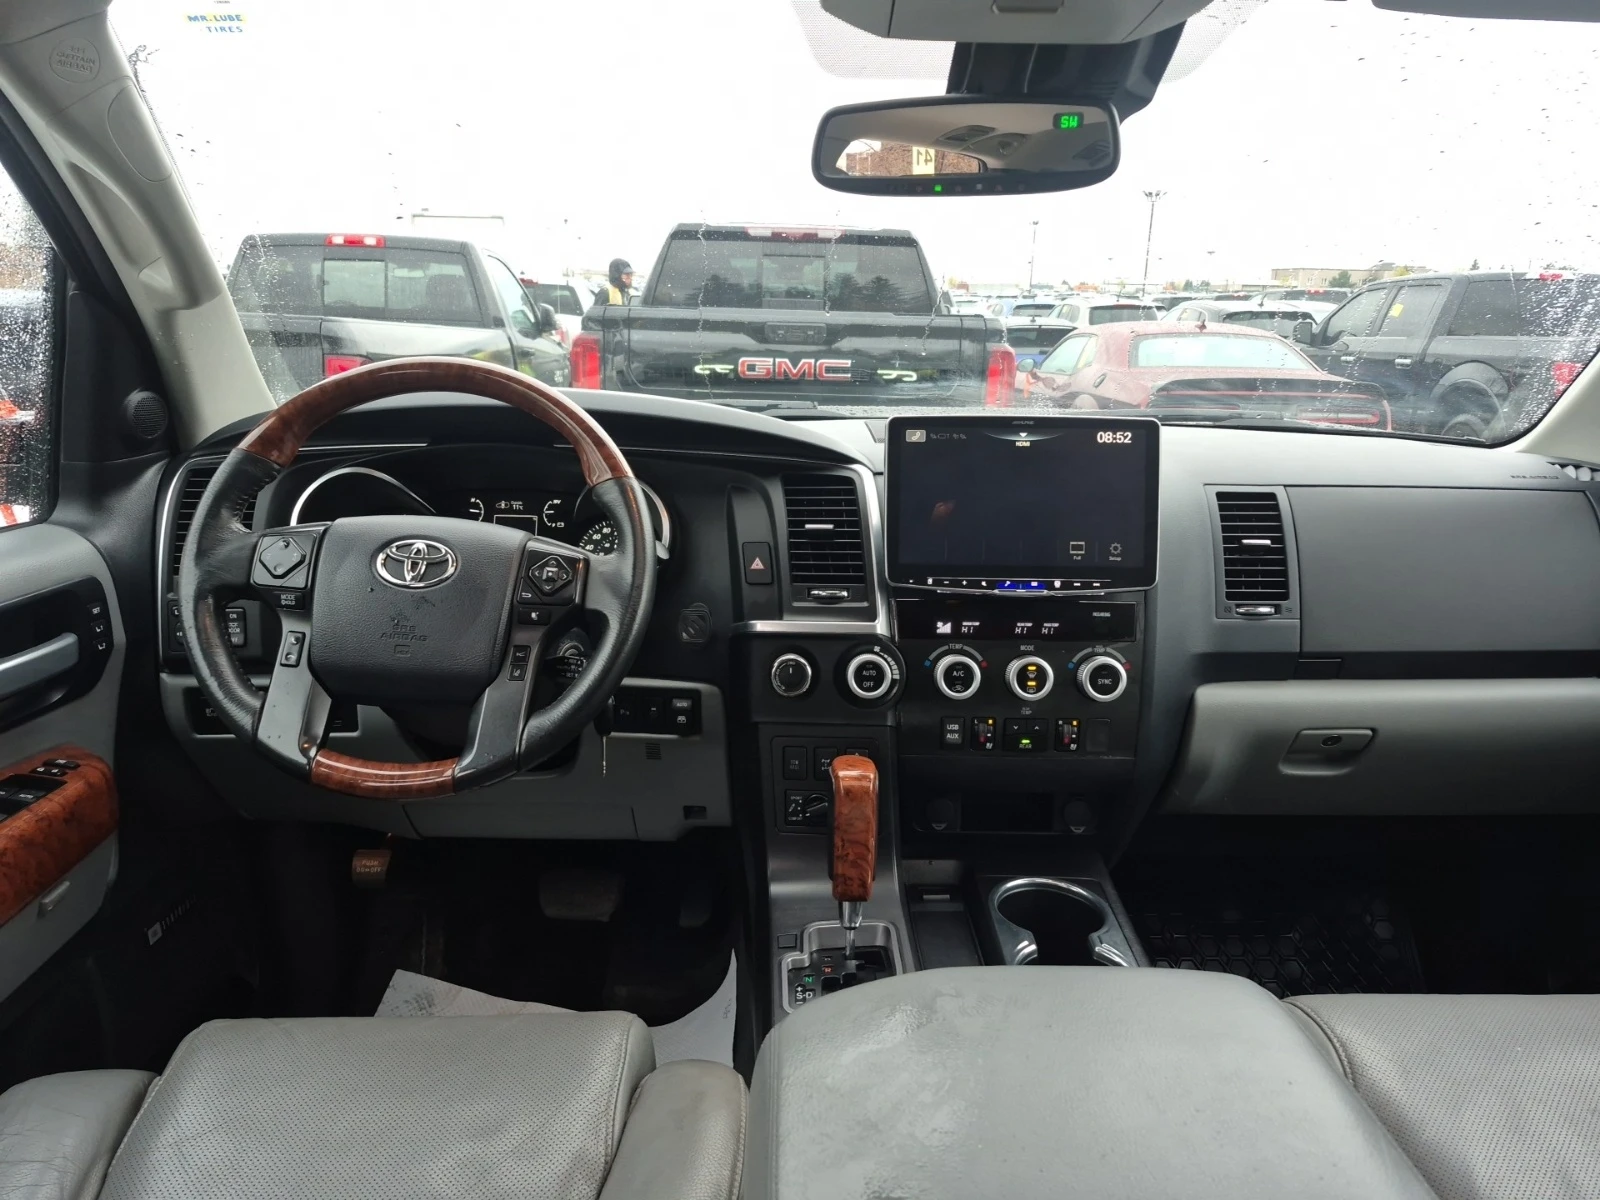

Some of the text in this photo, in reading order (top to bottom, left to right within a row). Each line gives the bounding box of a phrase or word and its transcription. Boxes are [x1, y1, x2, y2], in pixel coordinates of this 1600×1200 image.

[1060, 115, 1078, 129] SW
[738, 356, 852, 382] GMC
[1096, 432, 1132, 444] 08:52
[380, 632, 429, 642] AIRBAG
